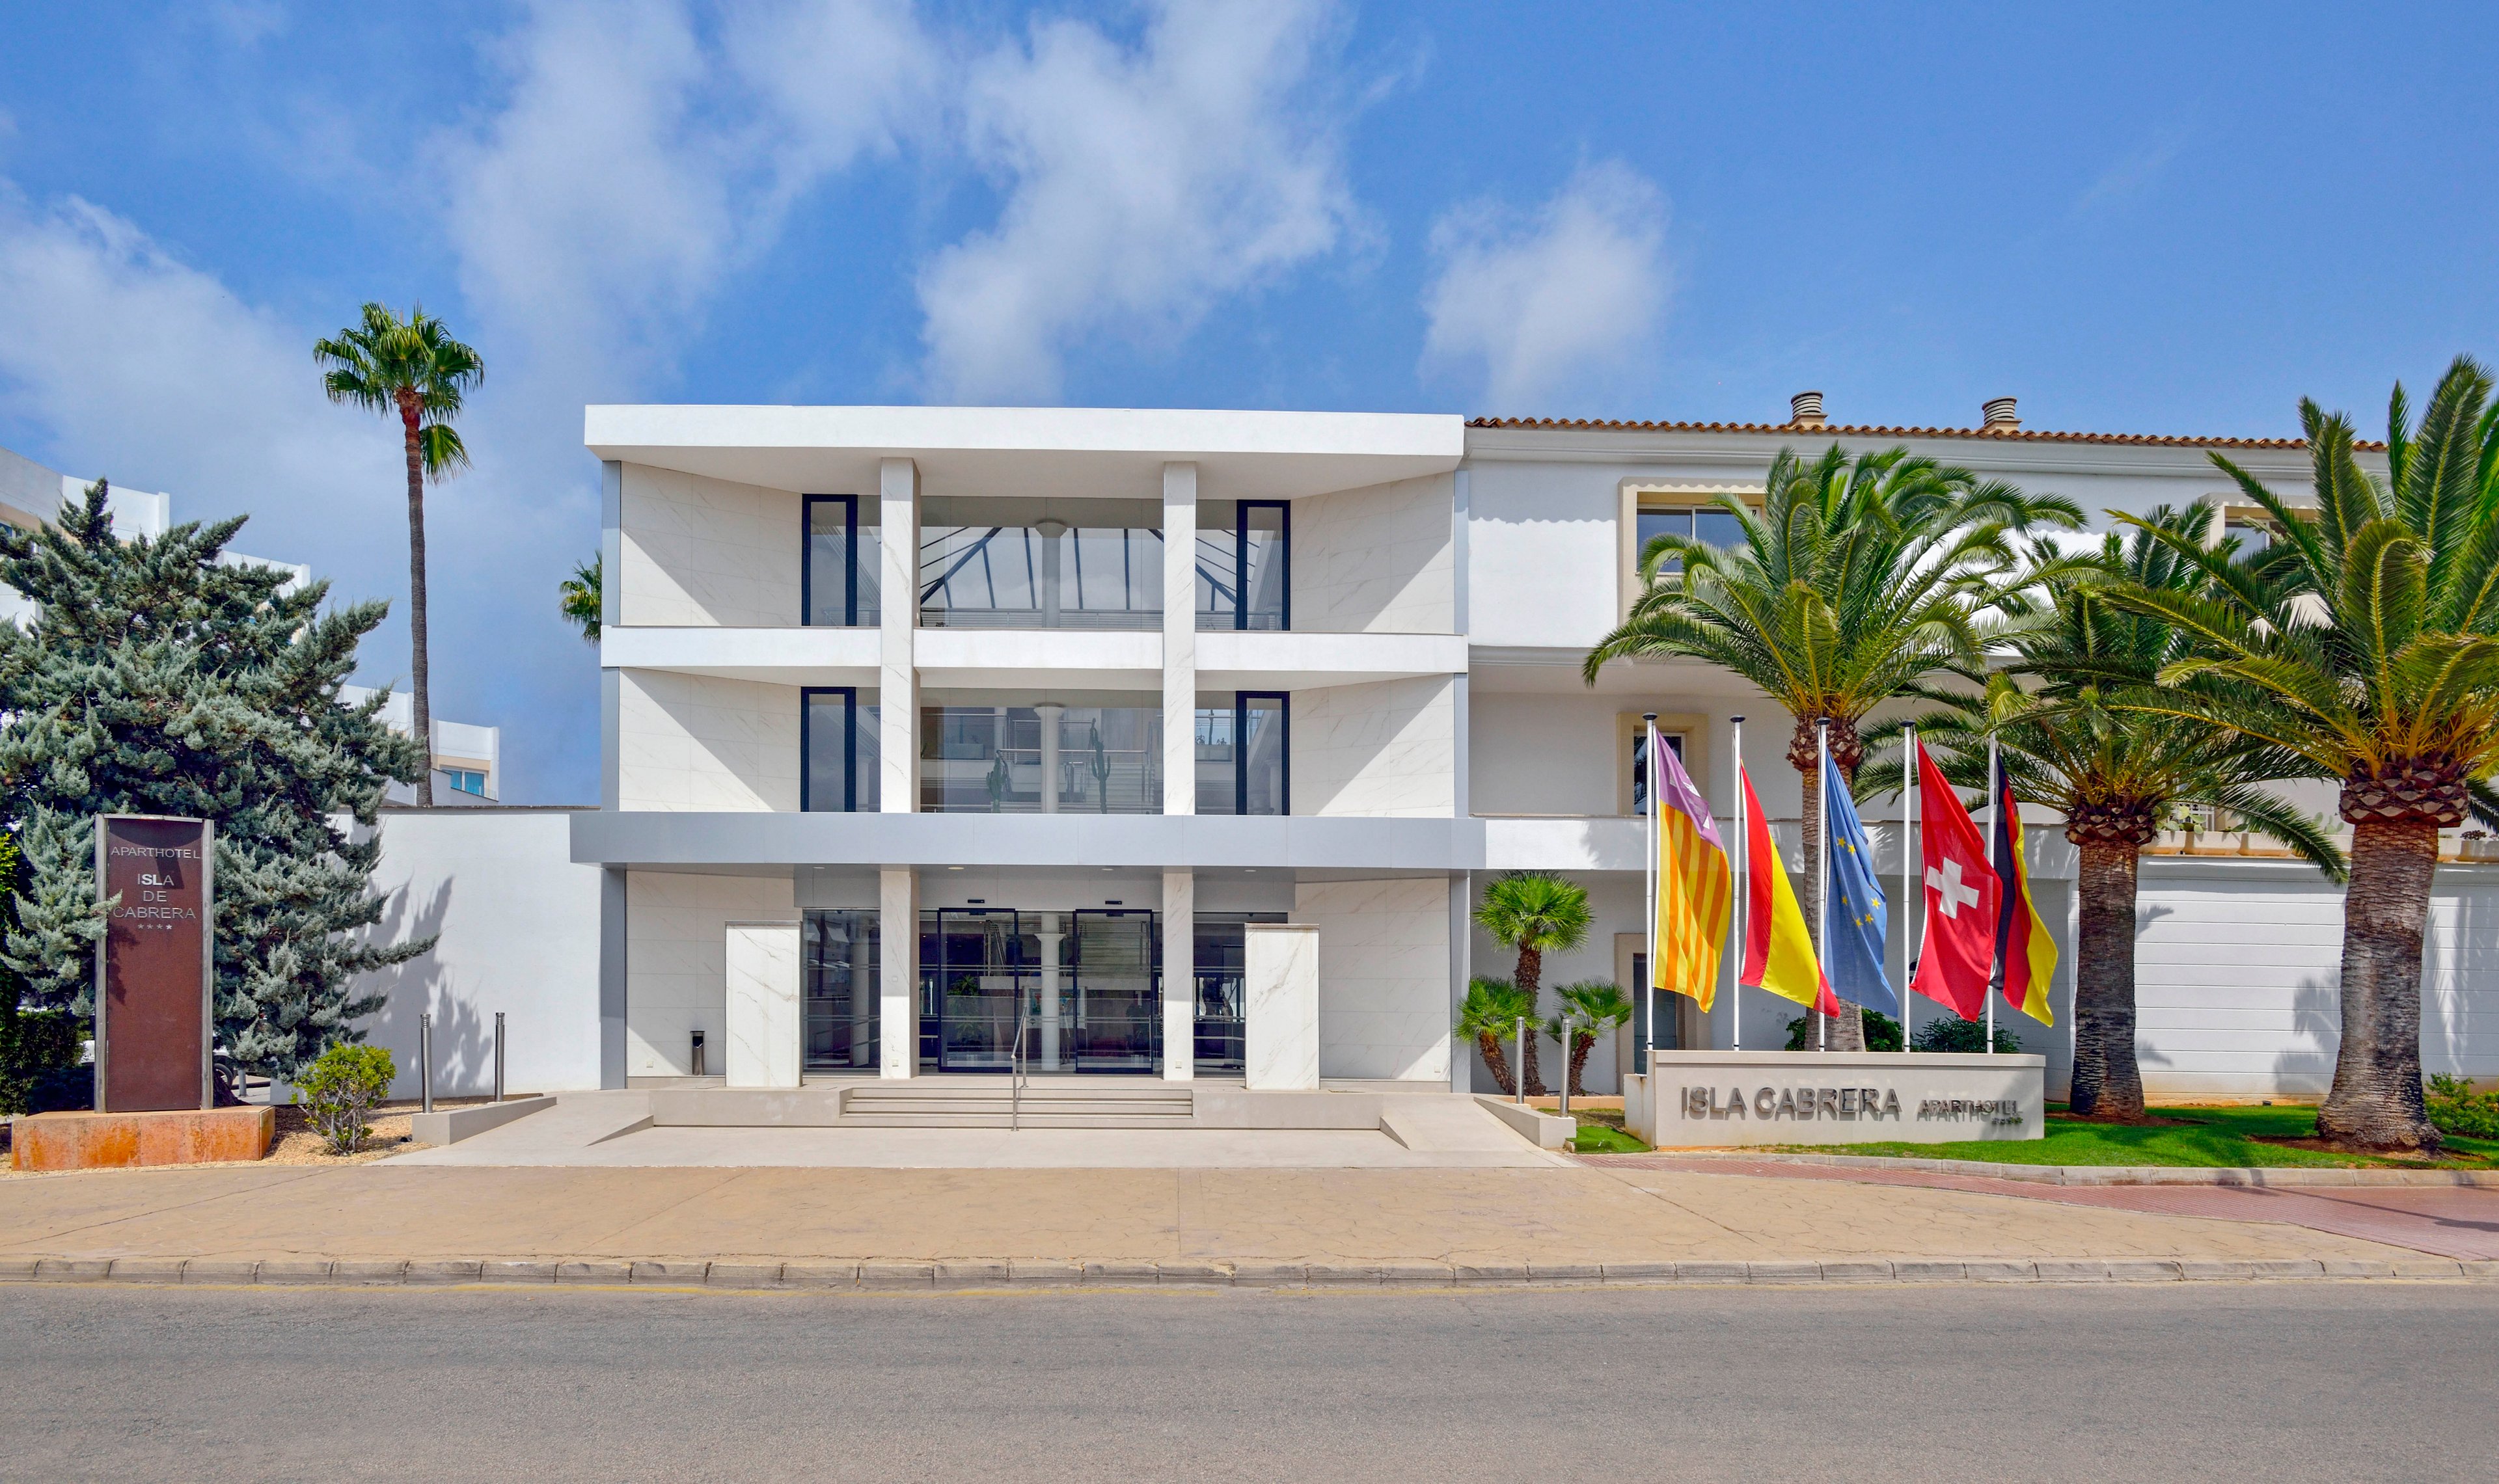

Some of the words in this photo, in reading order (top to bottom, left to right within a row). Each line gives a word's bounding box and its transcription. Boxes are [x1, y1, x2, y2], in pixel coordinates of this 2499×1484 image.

[111, 846, 200, 859] APARTHOTEL
[137, 874, 174, 886] ISLA
[143, 890, 167, 902] DE
[113, 907, 196, 919] CABRERA
[1681, 1086, 1748, 1113] ISLA
[1755, 1087, 1903, 1113] CABRERA
[1917, 1100, 2023, 1115] APARTHOTEL
